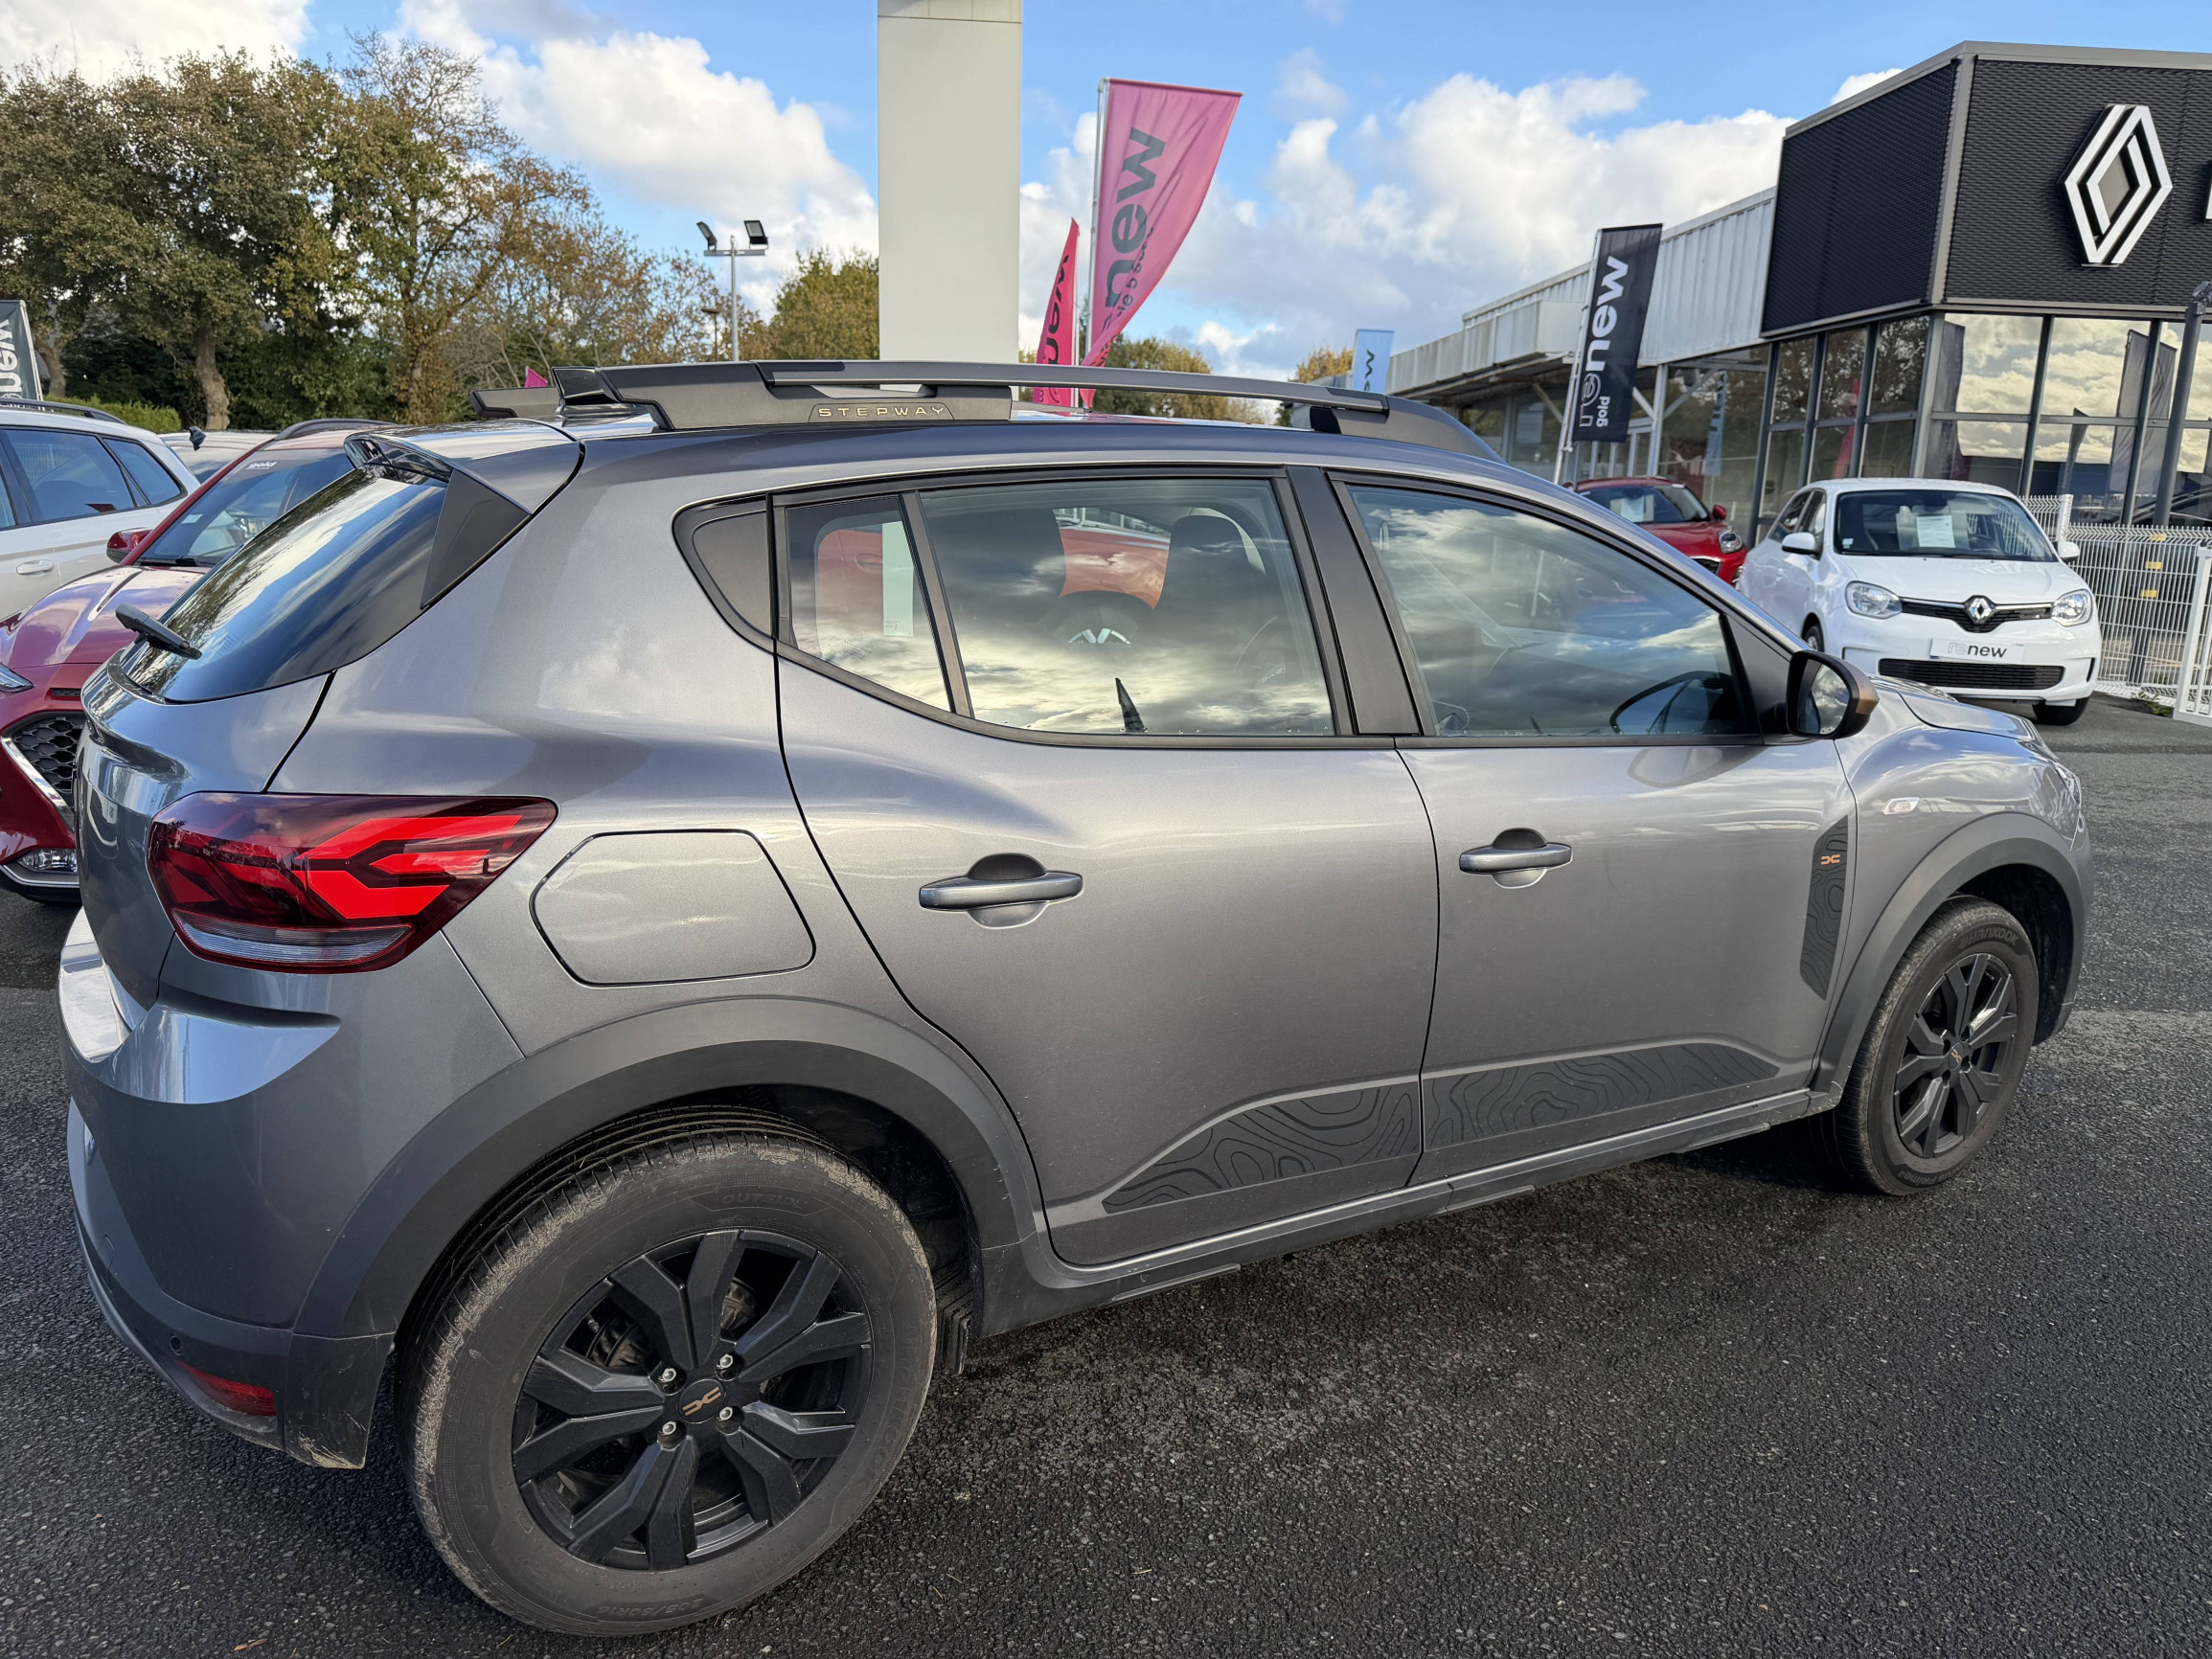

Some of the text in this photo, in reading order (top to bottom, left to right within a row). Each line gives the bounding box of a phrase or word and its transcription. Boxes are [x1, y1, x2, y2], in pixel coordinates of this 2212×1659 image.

[1102, 126, 1166, 331] new
[818, 406, 944, 417] STEPWAY
[1596, 396, 1610, 427] gold
[1948, 642, 2007, 658] renew
[720, 1193, 808, 1209] OUTSIDE
